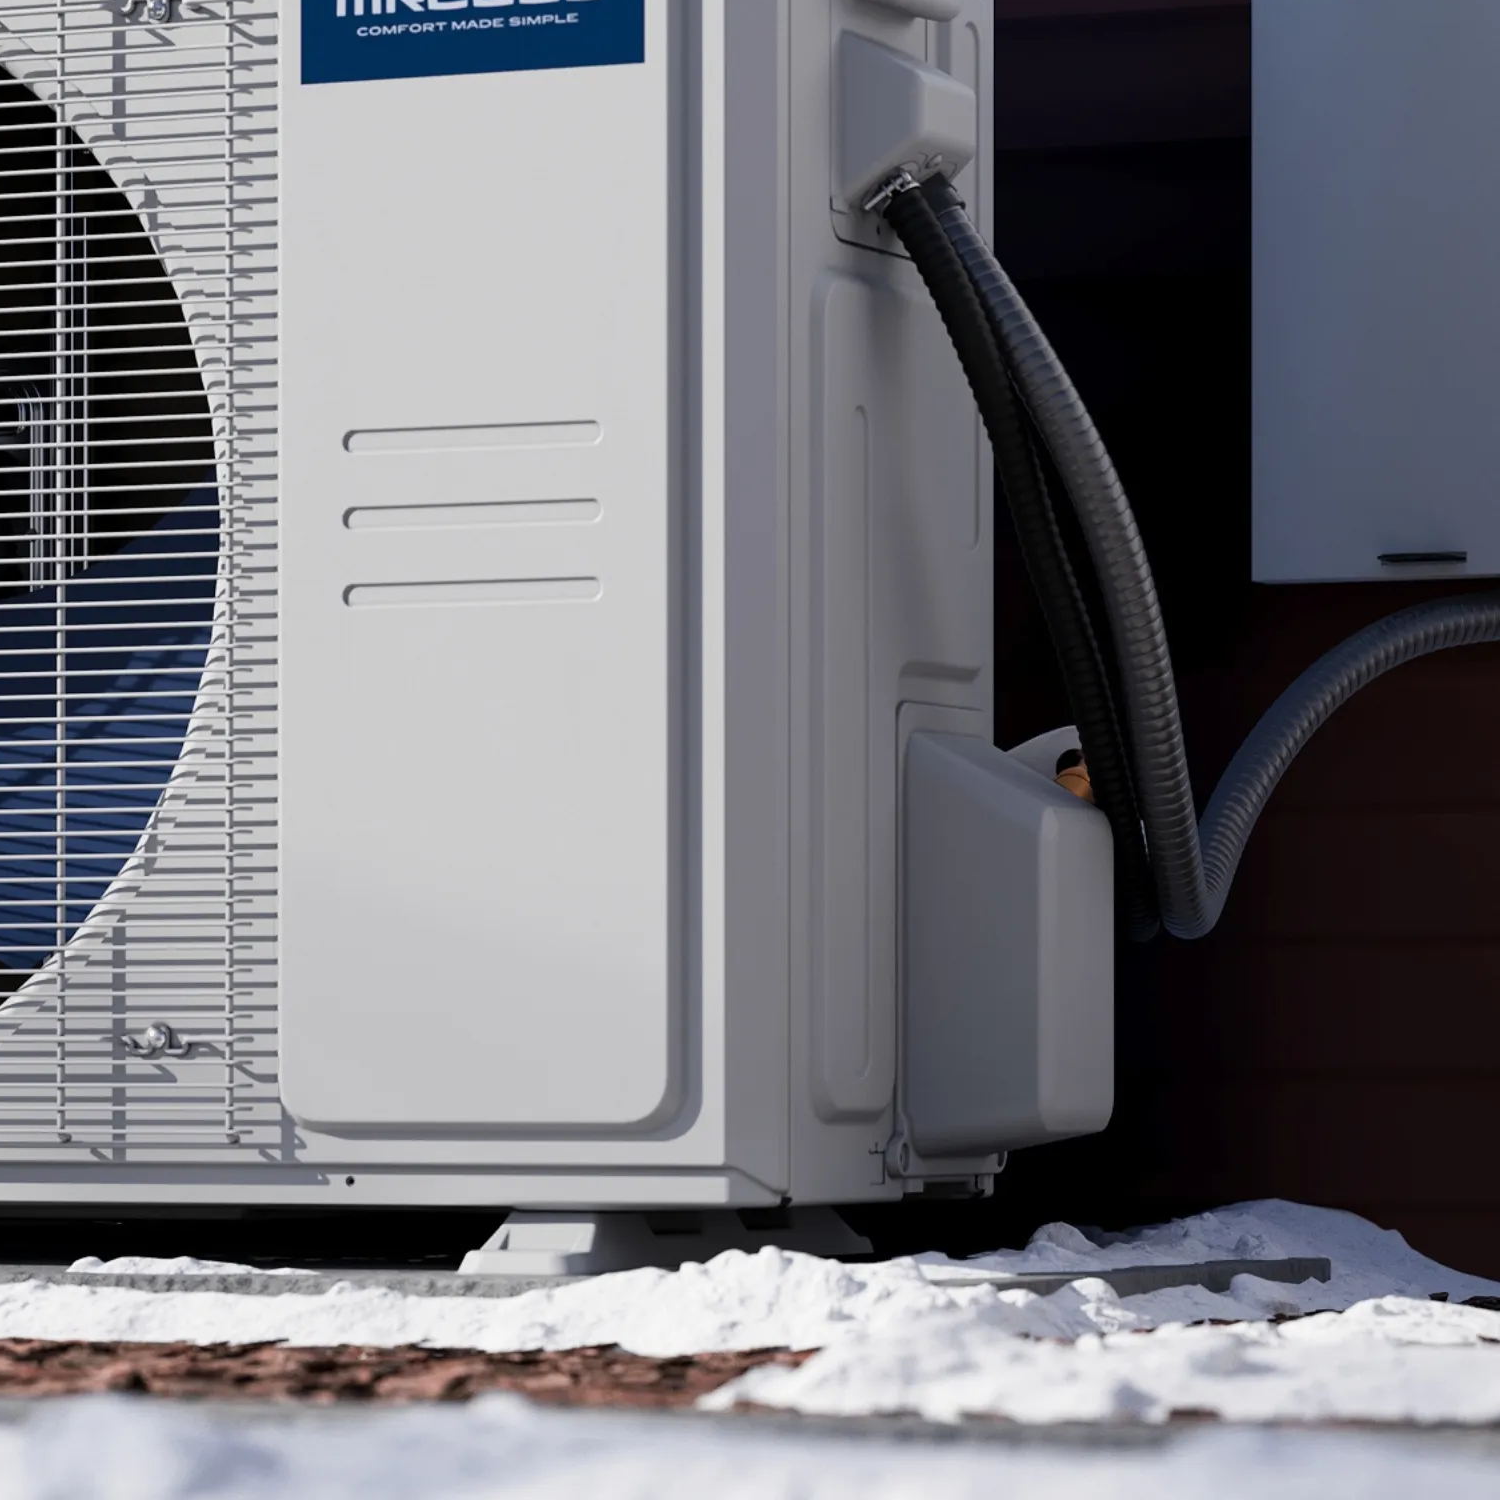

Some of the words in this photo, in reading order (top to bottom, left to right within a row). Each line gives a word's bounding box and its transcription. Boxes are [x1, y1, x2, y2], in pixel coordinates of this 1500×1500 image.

[356, 21, 448, 37] COMFORT
[451, 17, 504, 30] MADE
[509, 12, 579, 27] SIMPLE
